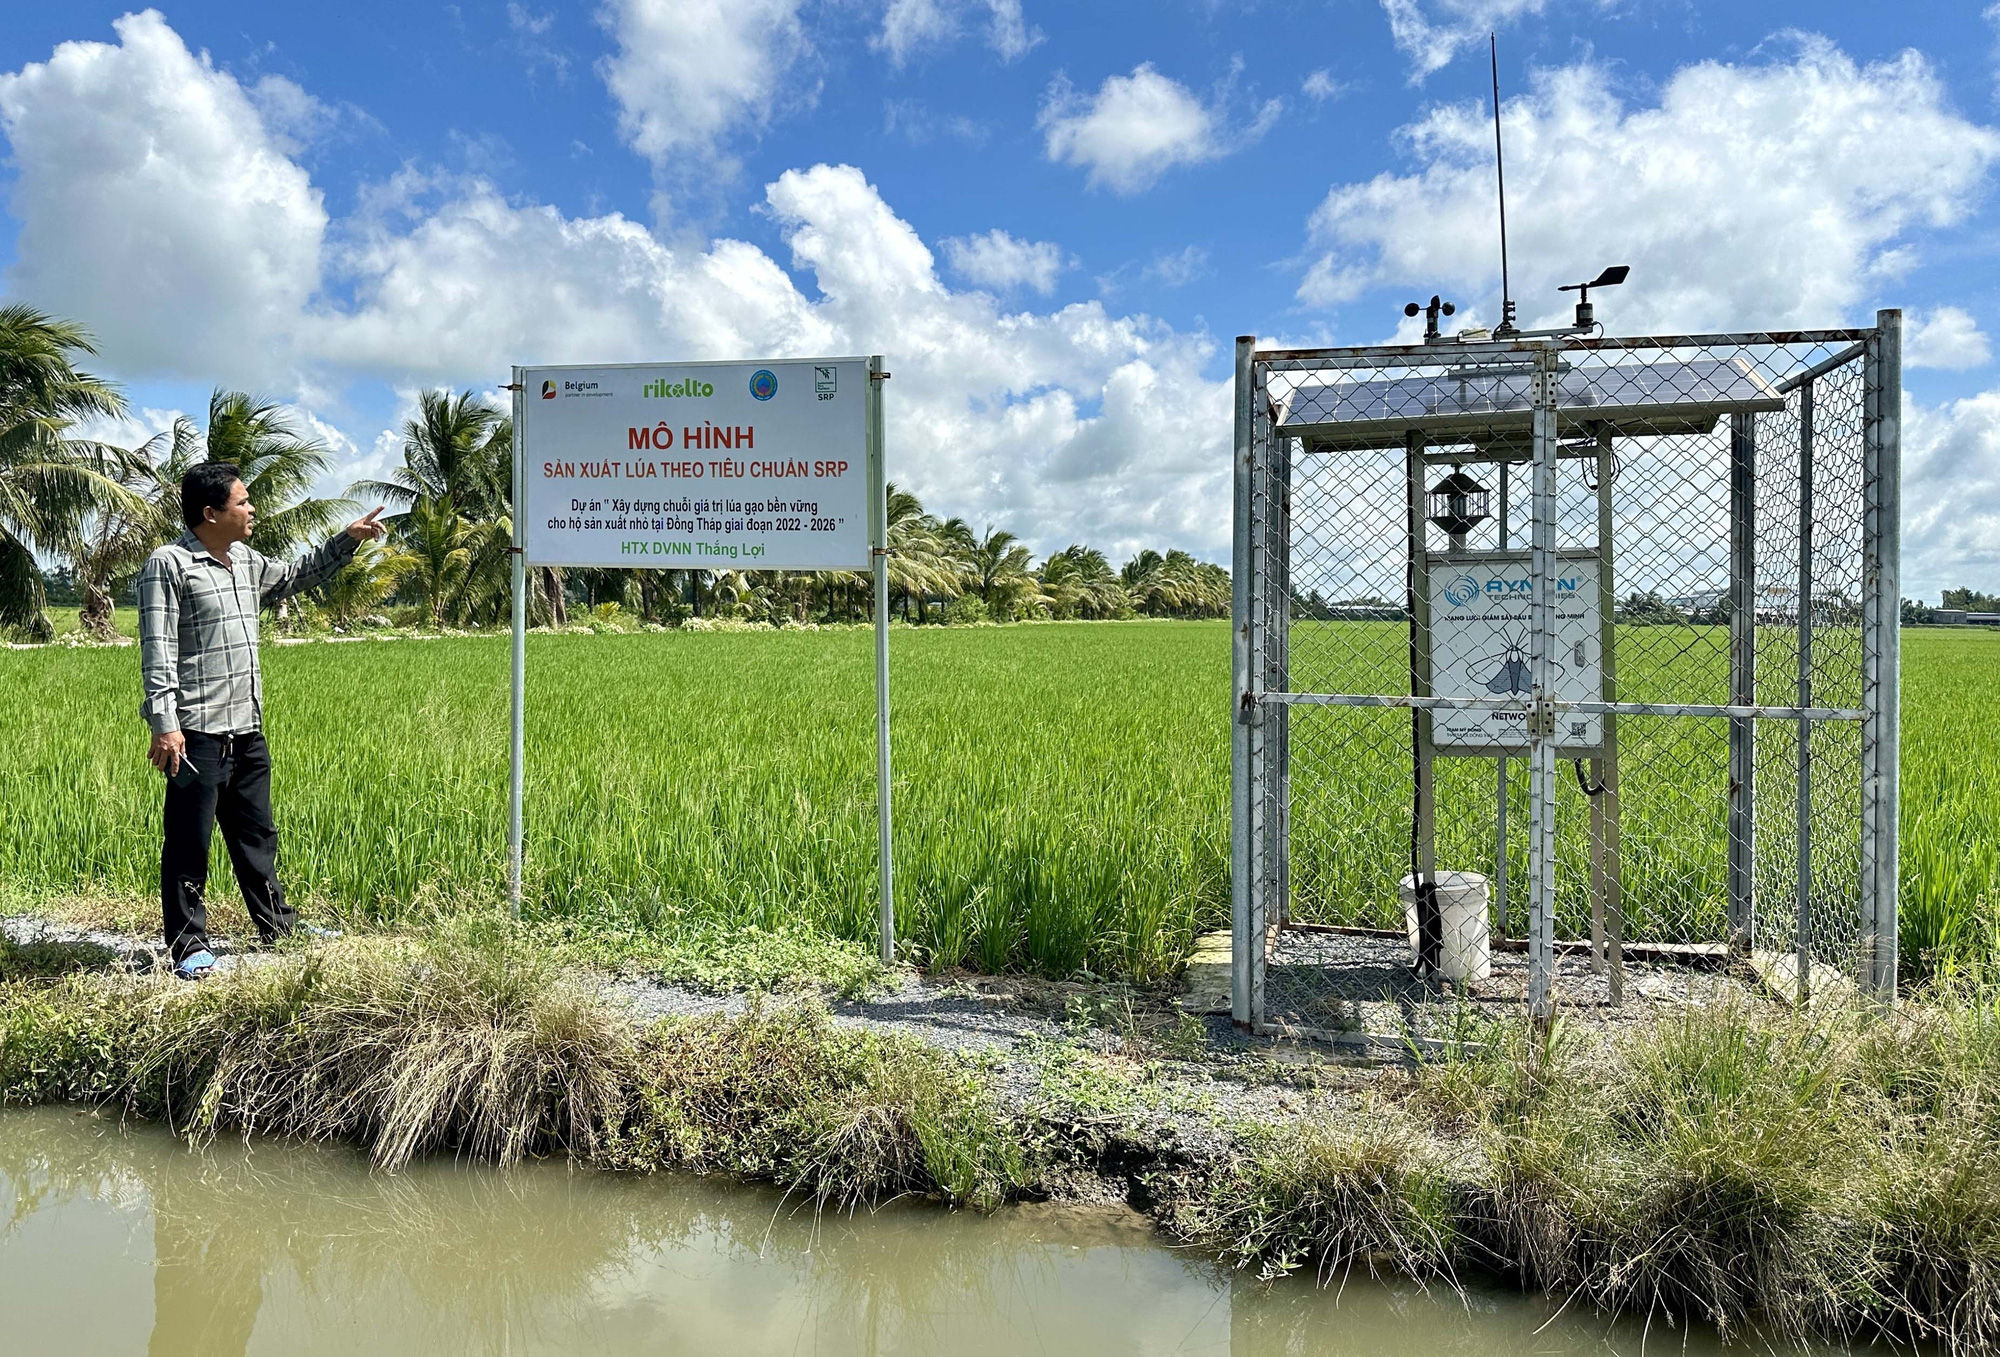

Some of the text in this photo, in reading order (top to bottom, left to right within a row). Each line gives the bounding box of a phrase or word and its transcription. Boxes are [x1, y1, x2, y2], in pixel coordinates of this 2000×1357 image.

[565, 381, 598, 392] Belgium
[643, 378, 714, 398] rikolto
[818, 393, 834, 401] SRP
[628, 420, 754, 450] MÔ HÌNH
[543, 457, 848, 478] SẢN XUẤT LÚA THEO TIÊU CHUẨN SRP
[571, 499, 587, 514] Dự
[589, 498, 601, 511] án
[612, 499, 630, 514] Xây
[633, 499, 660, 515] dựng
[663, 497, 691, 511] chuỗi
[694, 499, 709, 515] giá
[712, 499, 723, 515] trị
[726, 499, 741, 512] lúa
[744, 502, 764, 515] gạo
[767, 496, 787, 512] bền
[789, 499, 818, 515] vững
[548, 517, 566, 529] cho
[569, 517, 581, 532] hộ
[584, 517, 602, 530] sản
[605, 514, 626, 530] xuất
[629, 517, 649, 530] nhỏ
[652, 517, 664, 533] tại
[666, 514, 694, 533] Đồng
[697, 517, 722, 533] Tháp
[725, 517, 744, 533] giai
[747, 518, 772, 533] đoạn
[776, 518, 800, 531] 2022
[811, 518, 836, 531] 2026
[621, 540, 765, 559] HTX DVNN Thắng Lợi
[1486, 578, 1576, 592] RYNN
[1491, 712, 1528, 721] NETWO
